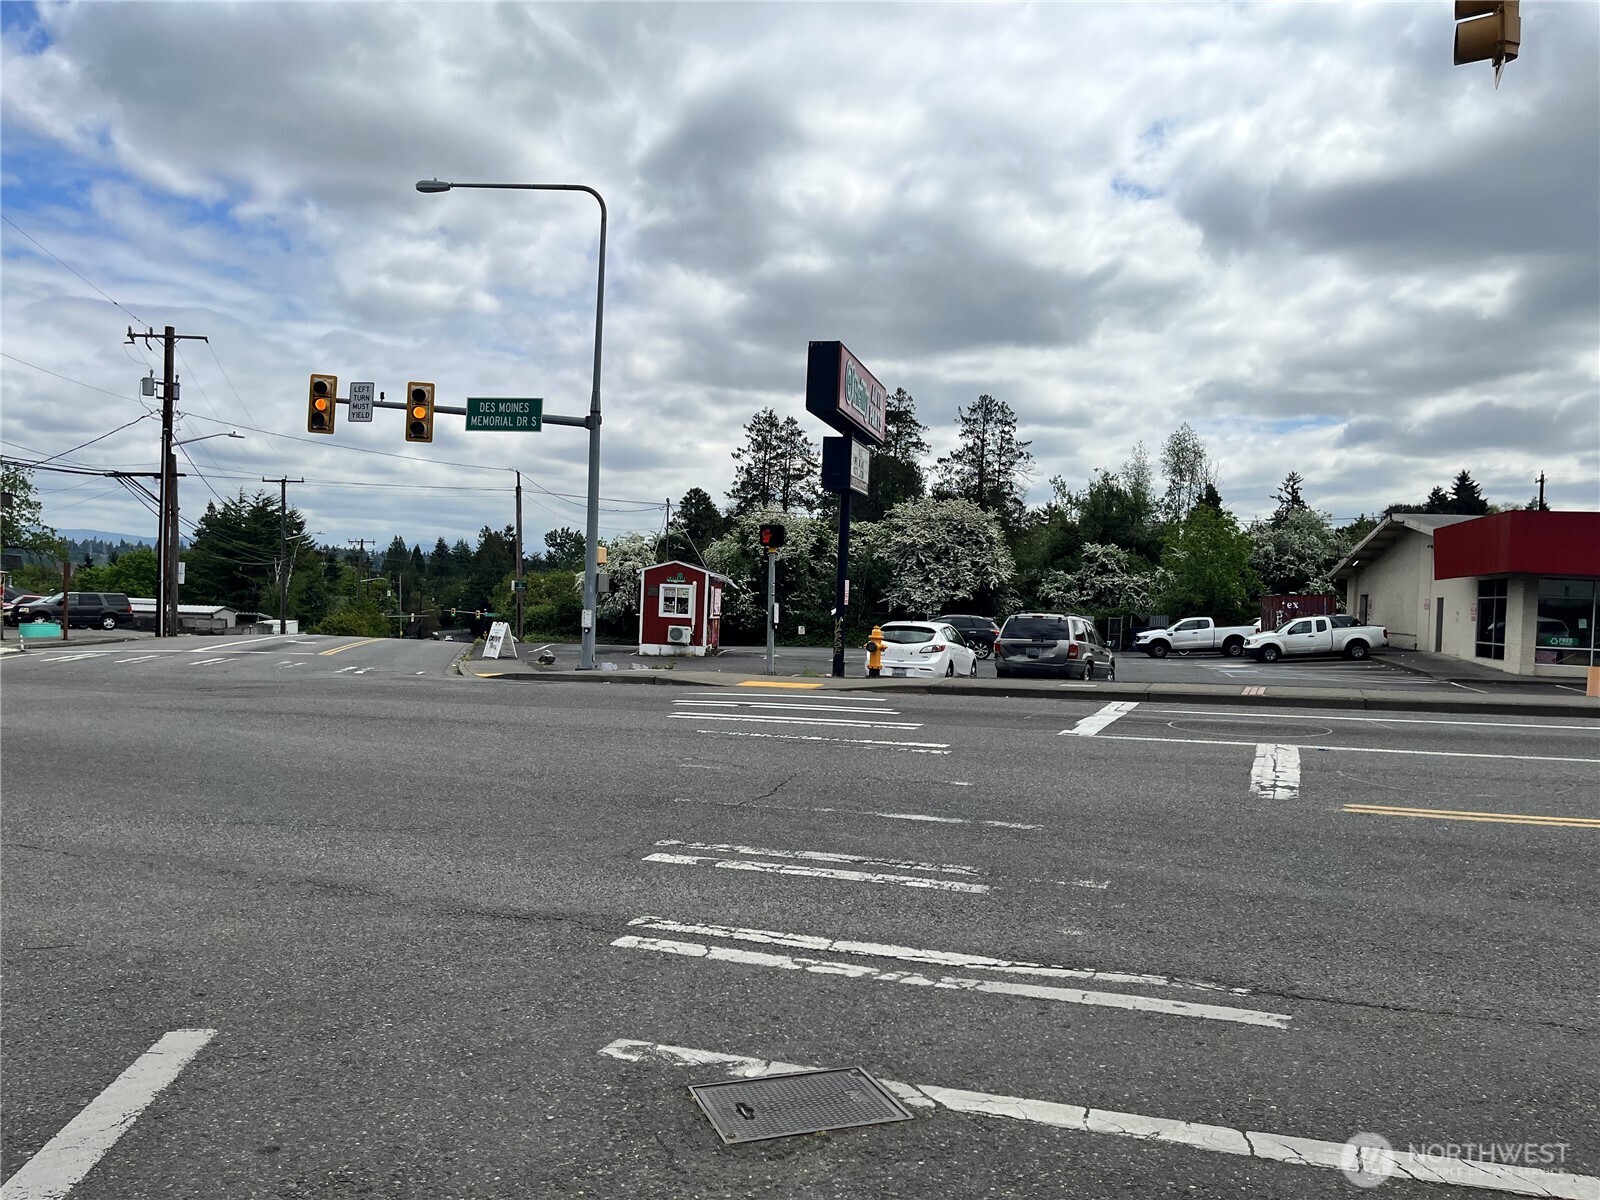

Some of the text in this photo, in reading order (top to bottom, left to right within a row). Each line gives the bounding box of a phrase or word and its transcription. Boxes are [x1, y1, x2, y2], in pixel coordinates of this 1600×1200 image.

[480, 402, 530, 413] DES MOINES
[351, 411, 370, 419] YIELD
[470, 415, 537, 427] MEMORIAL DR S
